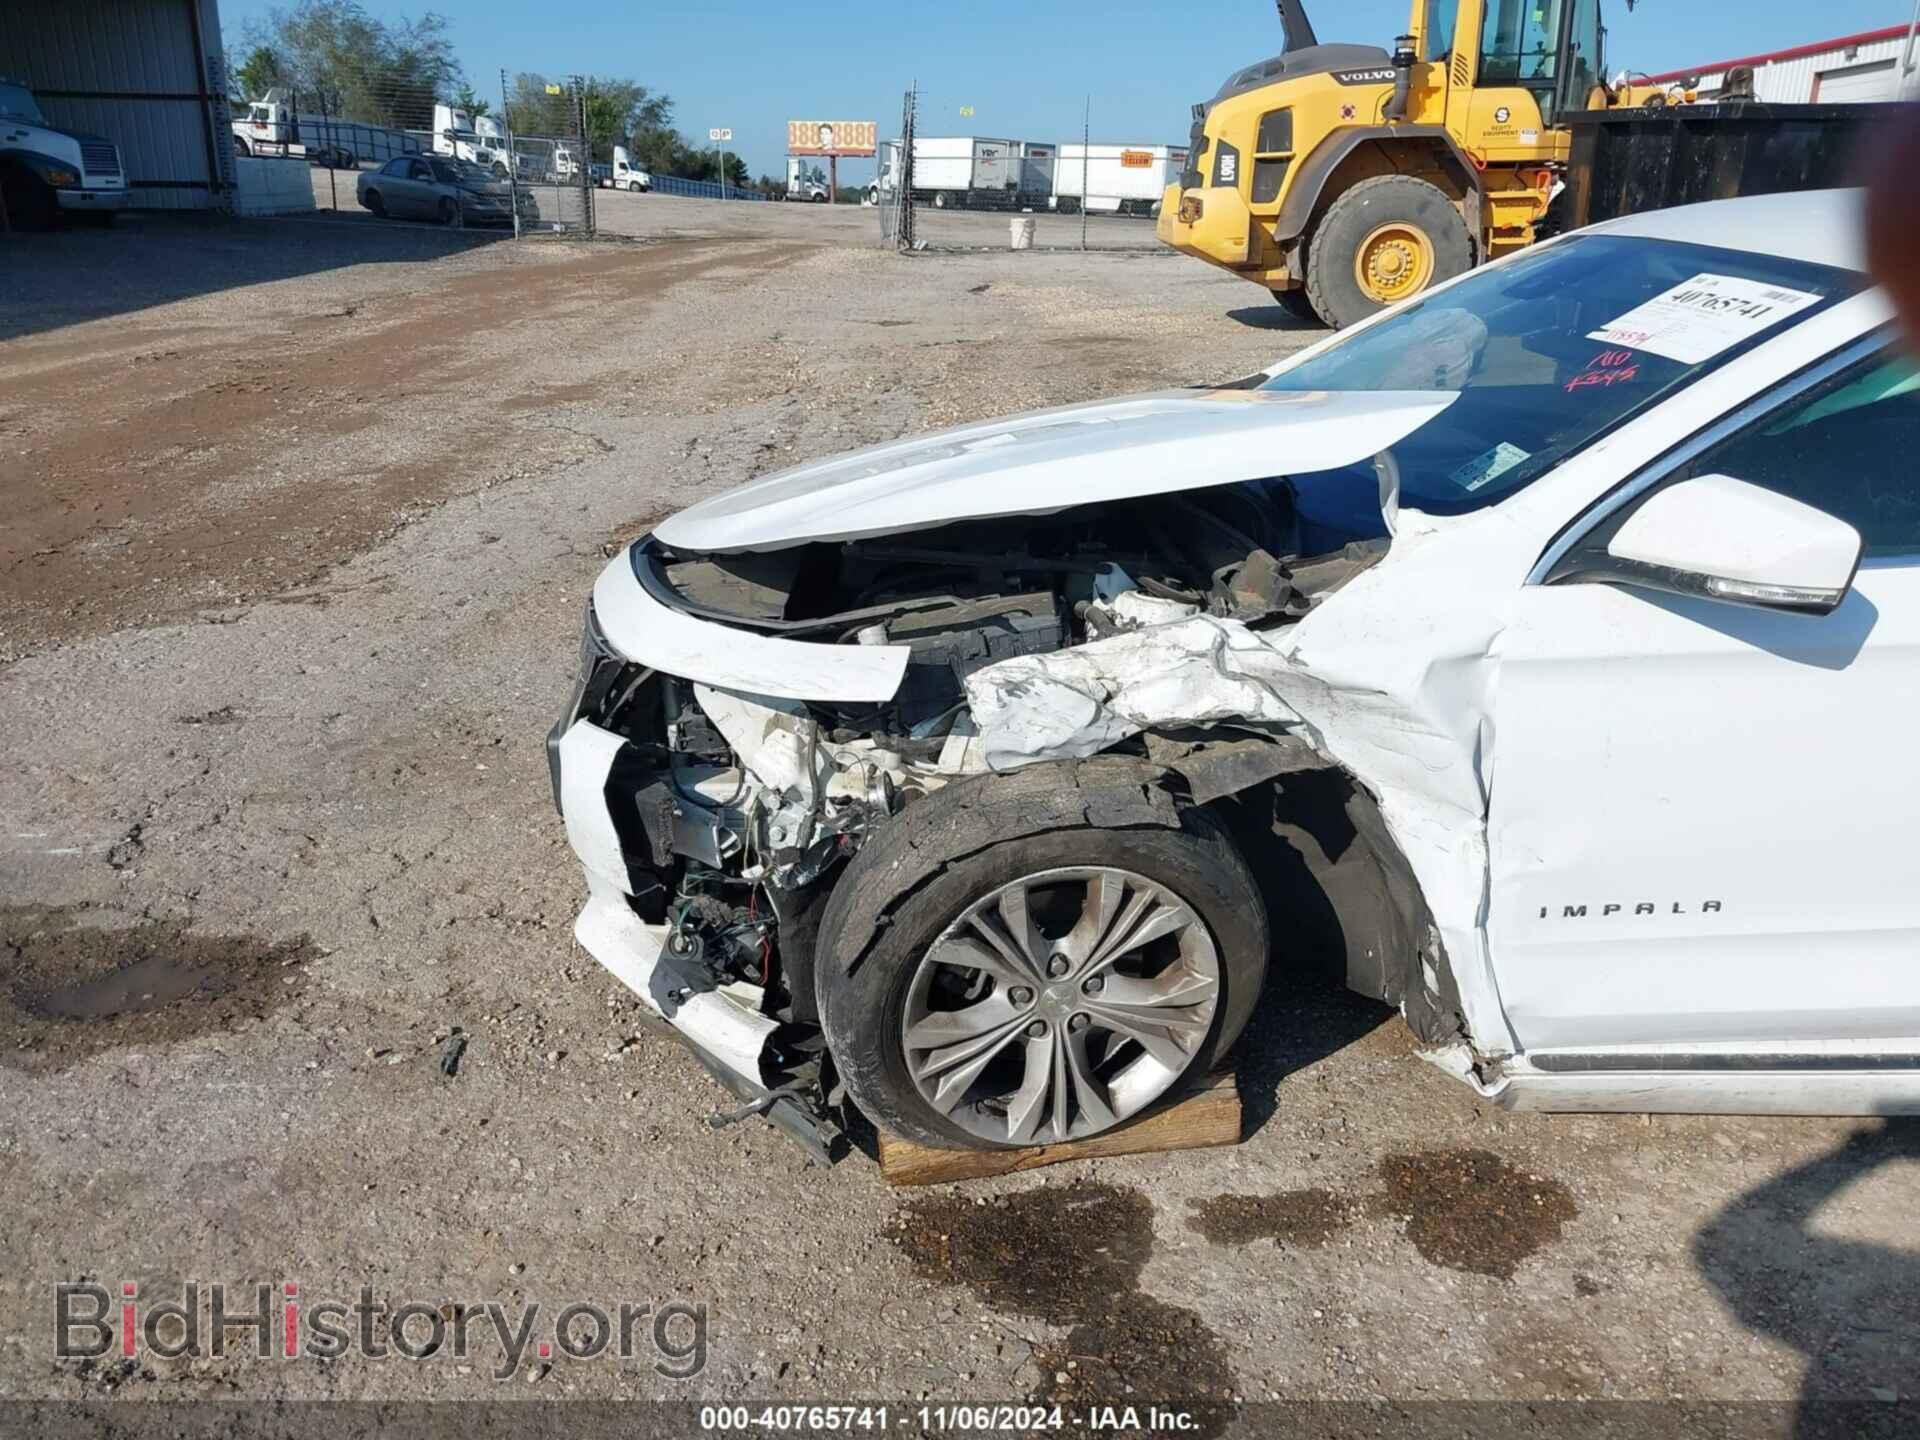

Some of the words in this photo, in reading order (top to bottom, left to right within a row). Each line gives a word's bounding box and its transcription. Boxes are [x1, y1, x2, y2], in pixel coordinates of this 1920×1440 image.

[1340, 70, 1396, 81] VOLVO
[1671, 290, 1774, 319] 40765741
[1586, 350, 1632, 369] NO
[1539, 900, 1722, 919] IMPALA
